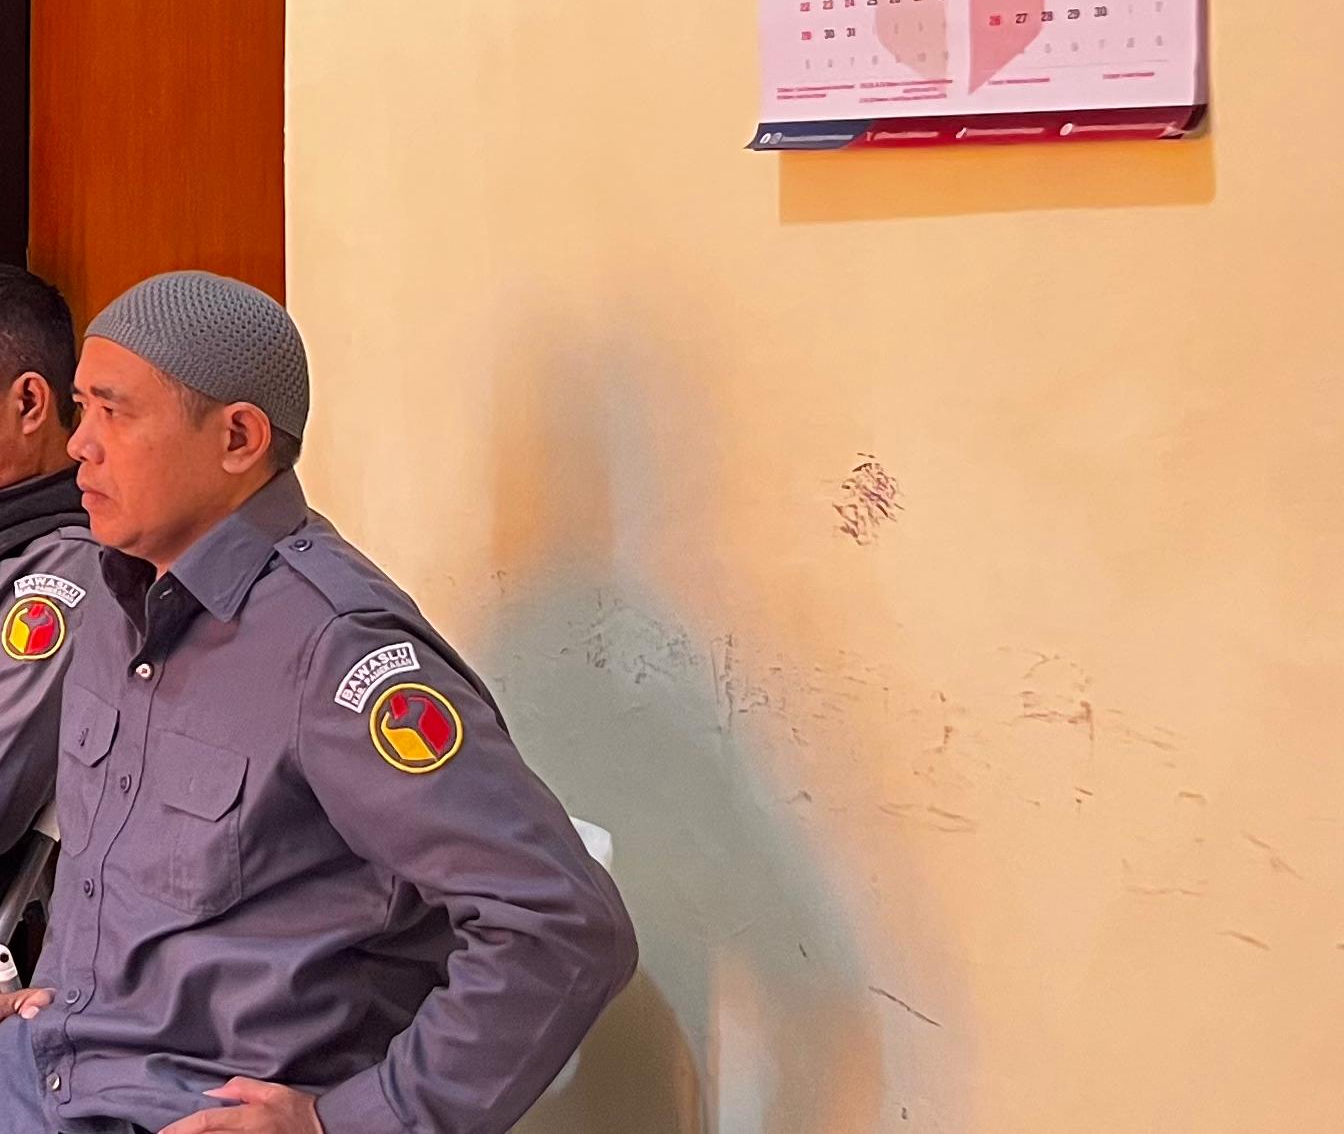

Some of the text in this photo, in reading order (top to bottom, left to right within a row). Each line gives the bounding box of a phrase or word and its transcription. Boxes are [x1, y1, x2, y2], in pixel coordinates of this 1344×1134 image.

[822, 0, 833, 10] 23
[1015, 13, 1028, 24] 27
[1041, 11, 1054, 22] 28
[1067, 9, 1080, 20] 29
[1094, 6, 1108, 17] 30
[824, 29, 835, 39] 30
[846, 27, 856, 38] 31
[341, 648, 408, 700] BAWASLU
